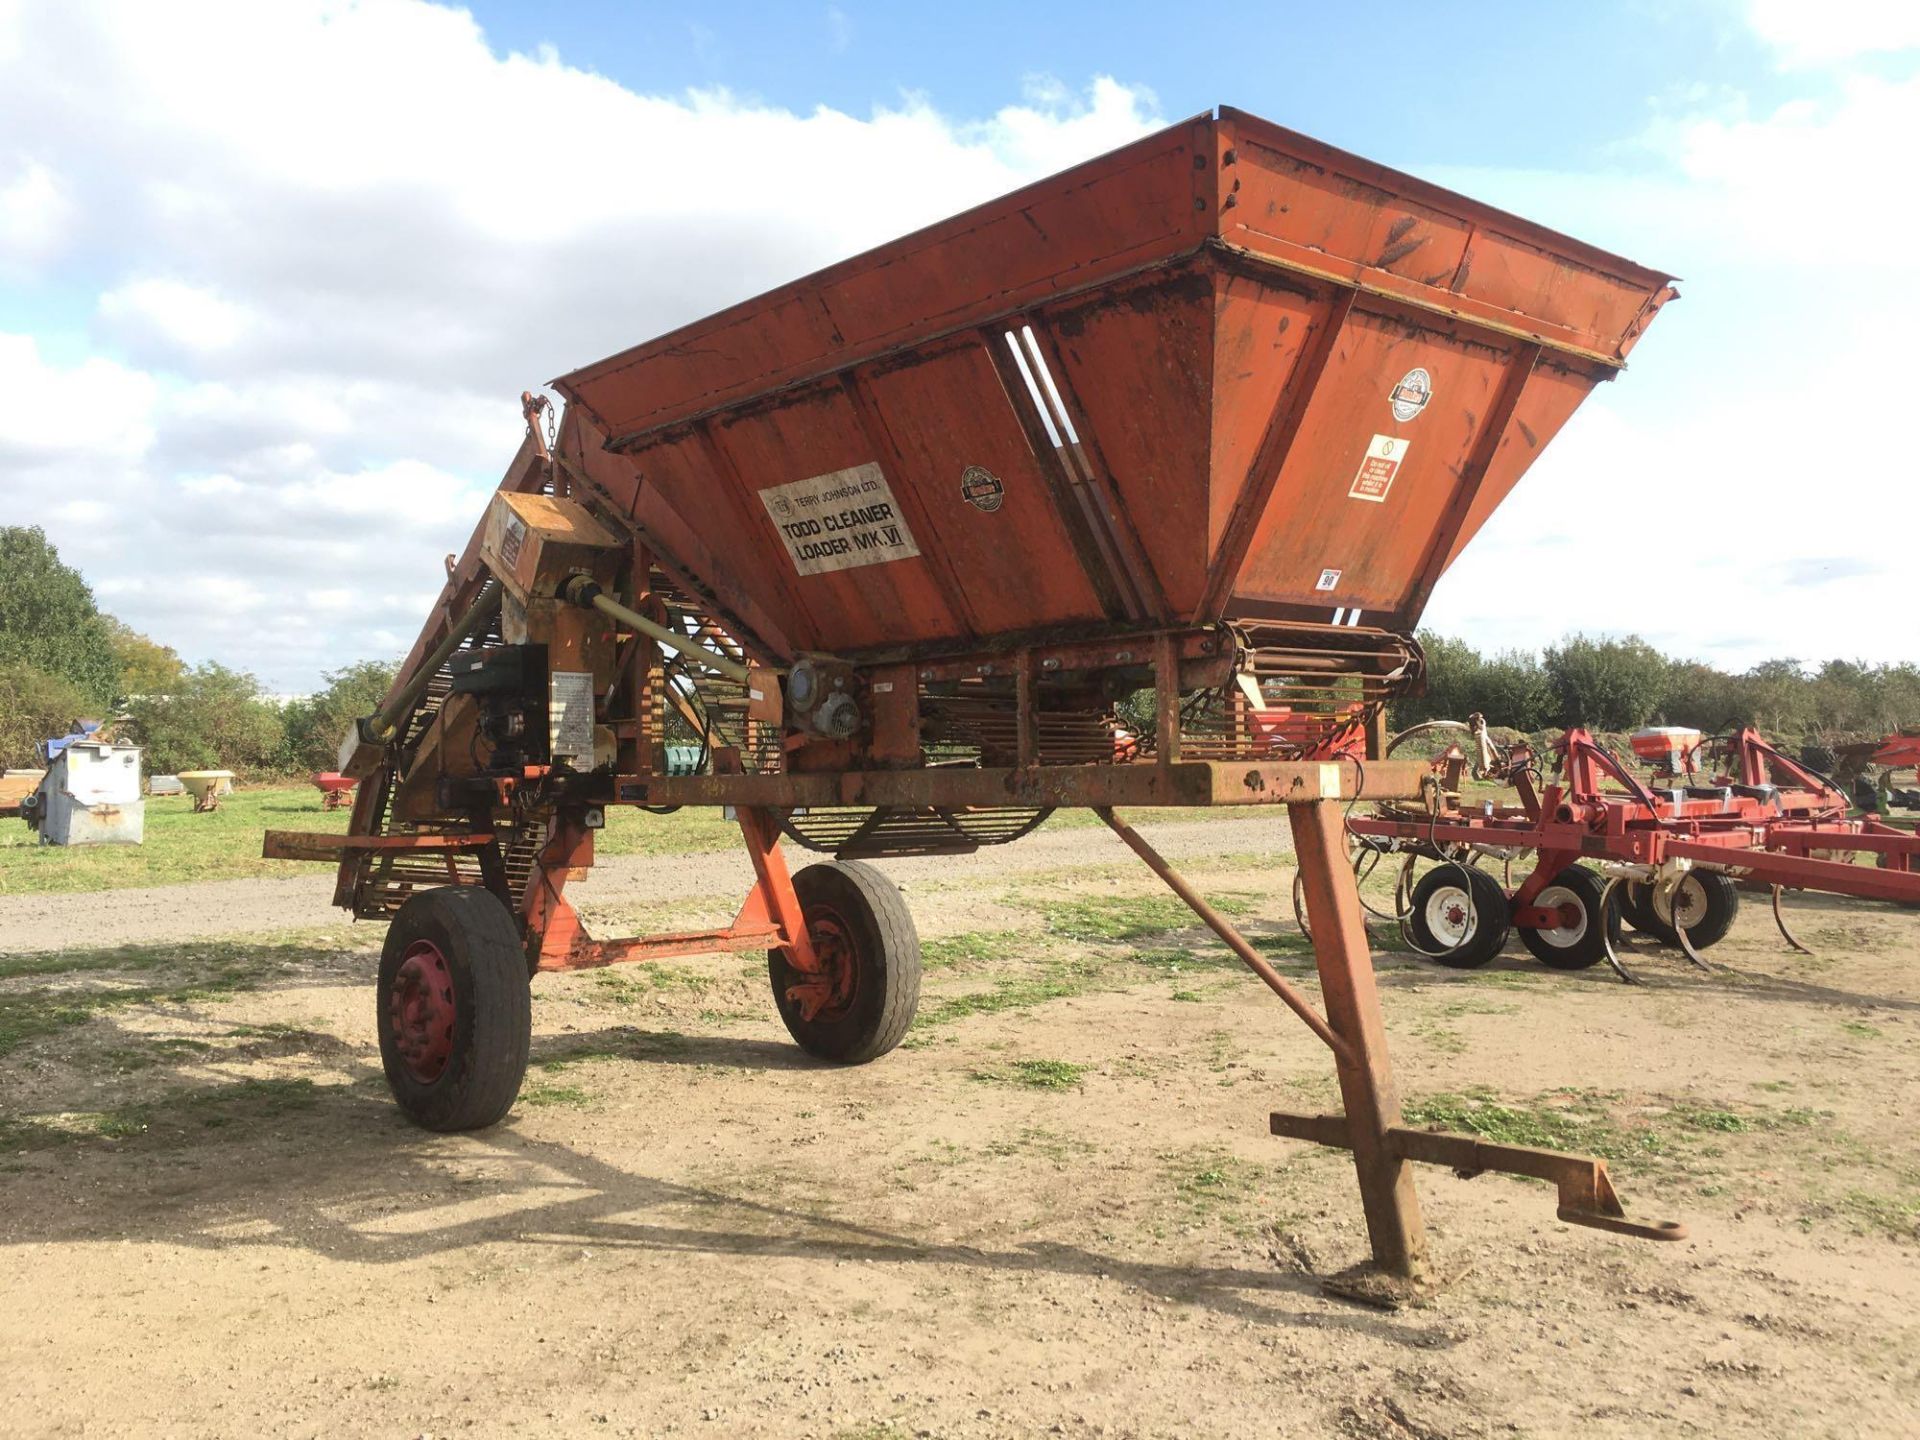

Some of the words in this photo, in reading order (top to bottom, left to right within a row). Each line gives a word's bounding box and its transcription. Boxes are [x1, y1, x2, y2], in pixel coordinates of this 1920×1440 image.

[794, 493, 820, 508] TERRY
[822, 486, 862, 502] JOHNSON
[782, 519, 821, 539] TODD
[824, 503, 894, 532] CLEANER
[796, 537, 852, 561] LOADER
